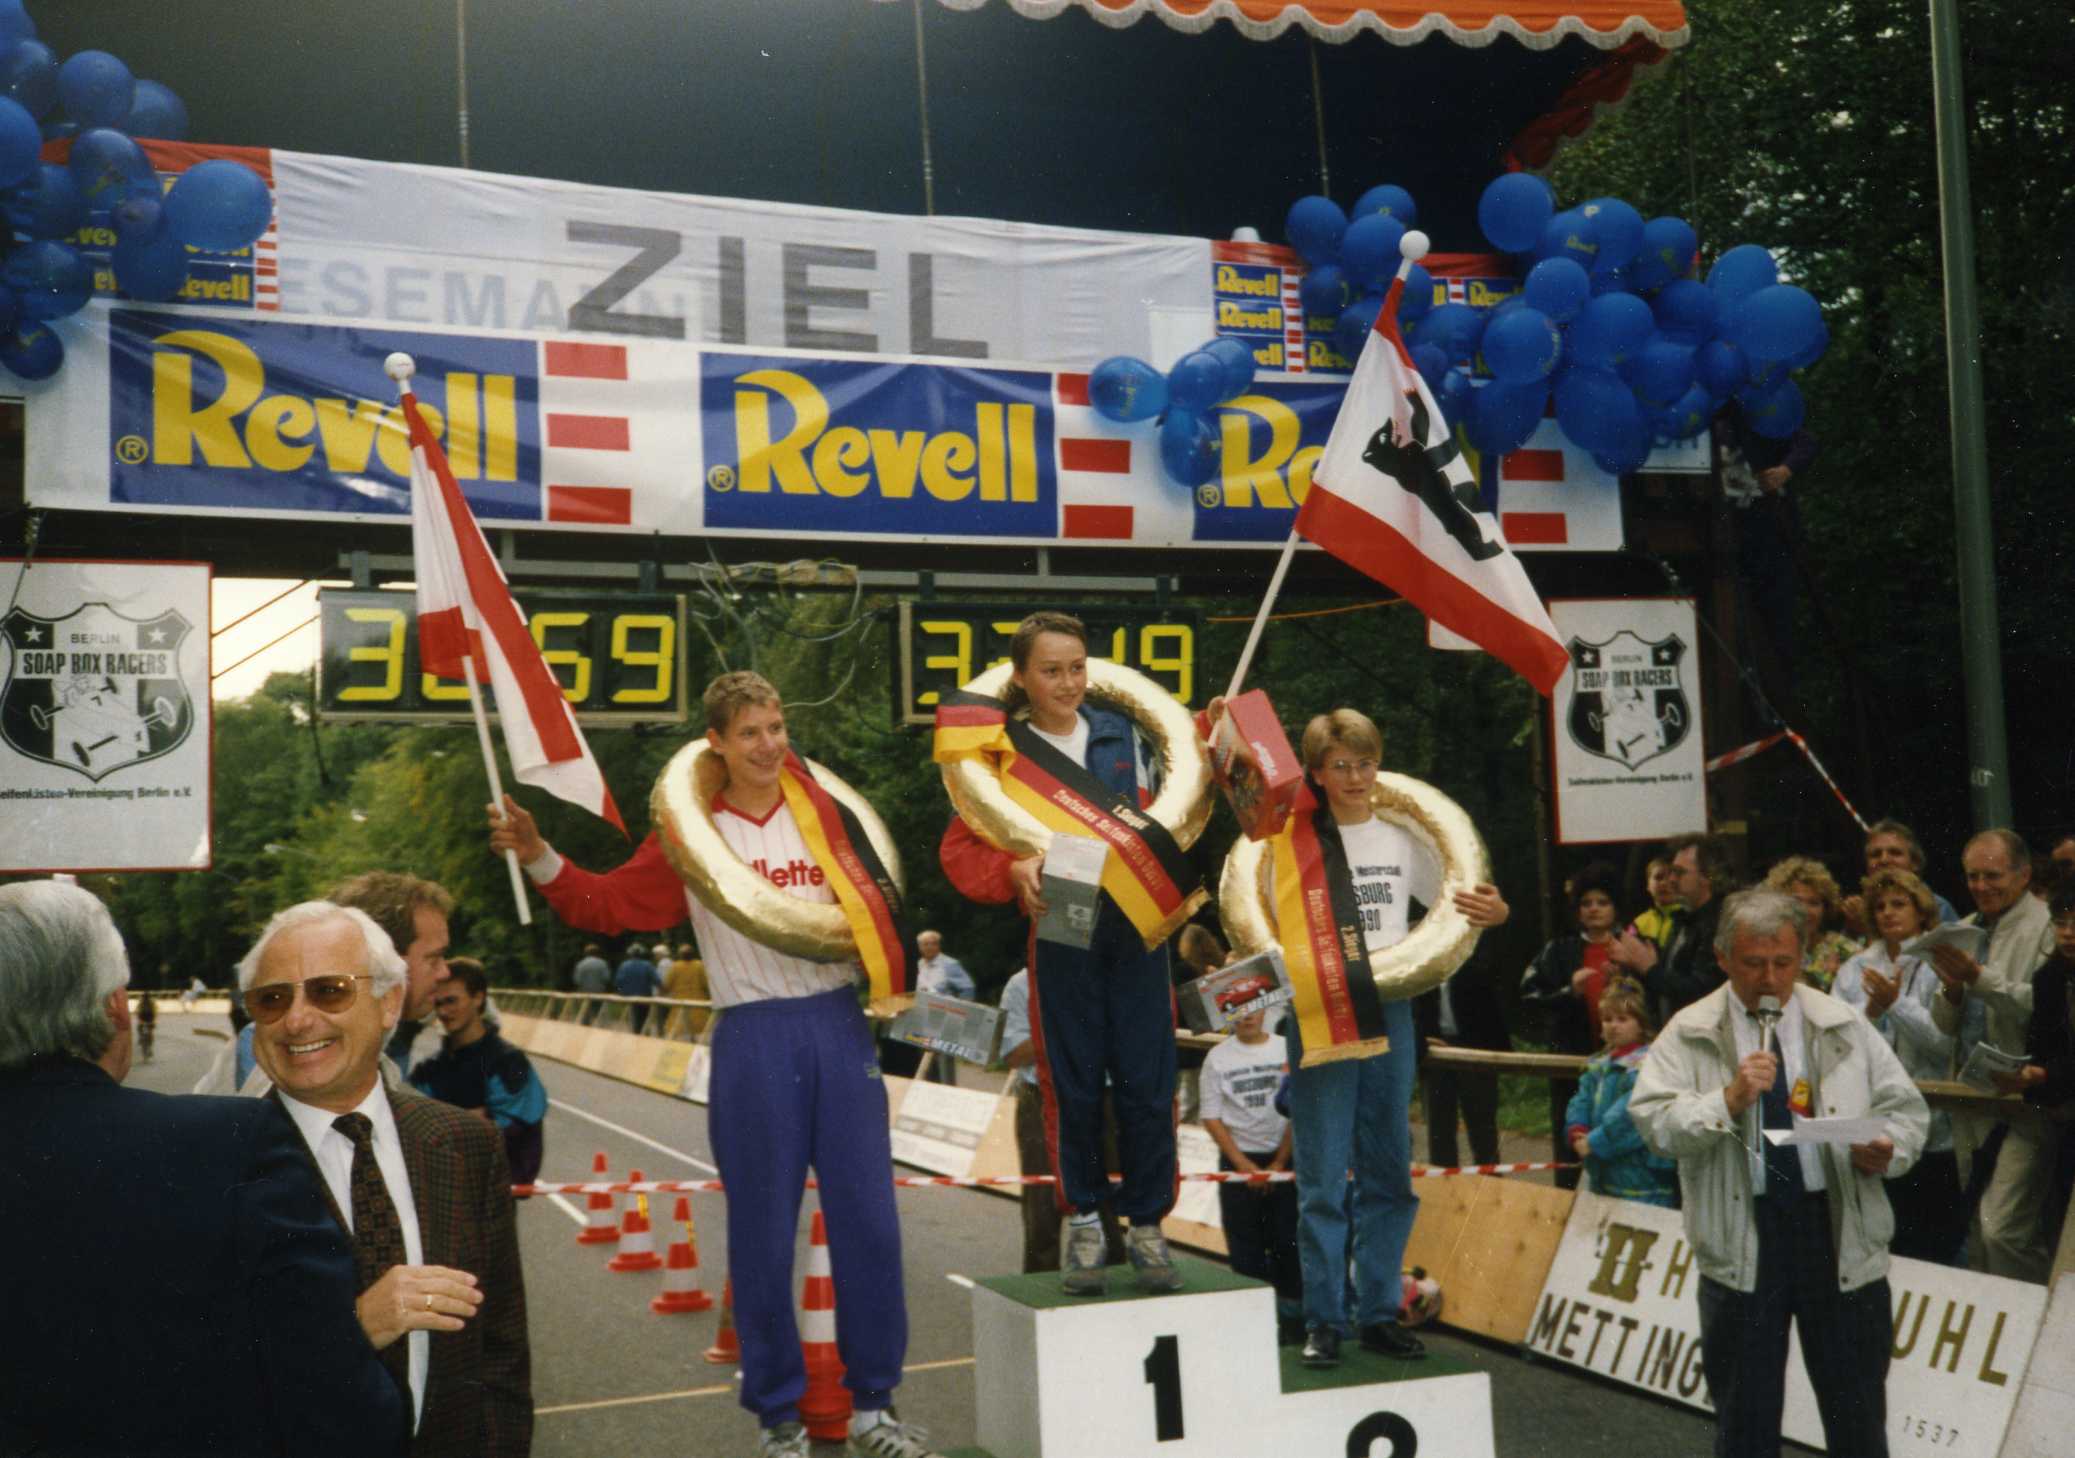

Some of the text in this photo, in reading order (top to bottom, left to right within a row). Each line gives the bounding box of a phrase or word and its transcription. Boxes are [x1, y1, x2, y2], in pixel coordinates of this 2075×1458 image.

[178, 269, 250, 303] evell
[566, 219, 989, 359] ZIEL
[1216, 265, 1279, 297] Revell
[1218, 301, 1283, 330] Revell
[1252, 342, 1284, 367] vell
[152, 330, 517, 481] Revell
[734, 369, 1038, 503] Revell
[70, 633, 121, 644] BERLIN
[23, 653, 168, 676] SOAP BOX RACERS
[1531, 1293, 1710, 1405] METTING
[1144, 1334, 1184, 1443] 1
